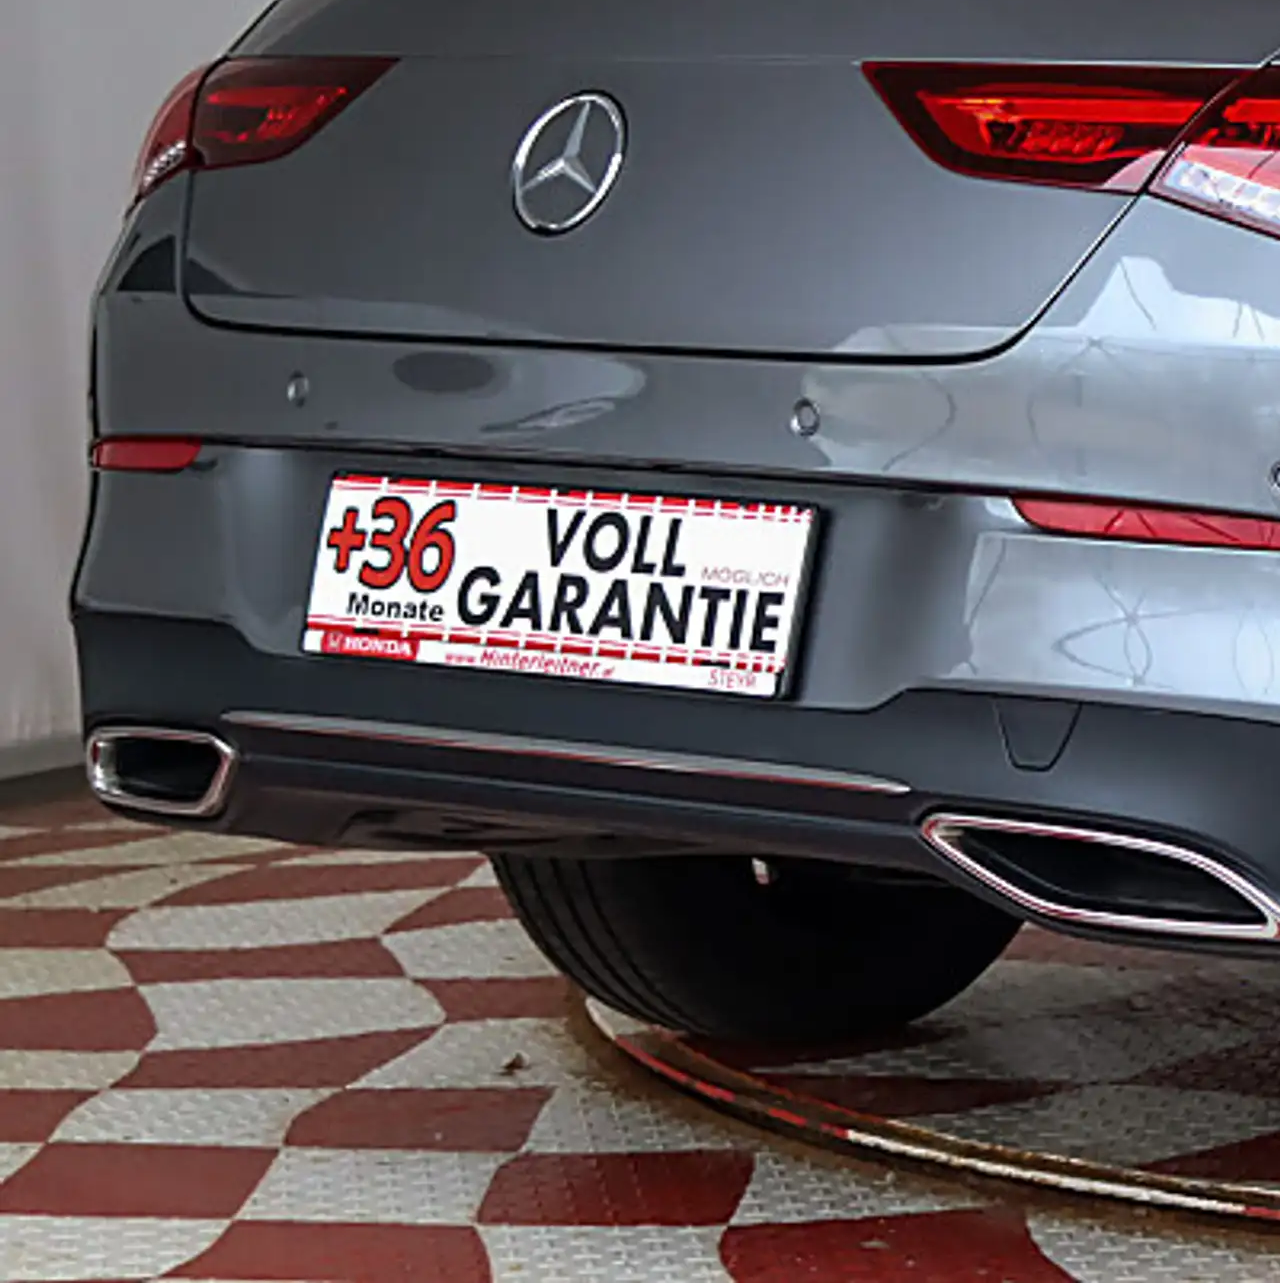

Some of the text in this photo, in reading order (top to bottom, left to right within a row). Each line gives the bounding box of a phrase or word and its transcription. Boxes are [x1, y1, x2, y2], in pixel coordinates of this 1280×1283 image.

[327, 495, 456, 594] +36
[546, 507, 687, 578] VOLL
[346, 592, 444, 622] Monate
[456, 565, 785, 653] GARANTIE
[344, 637, 412, 656] HONDA
